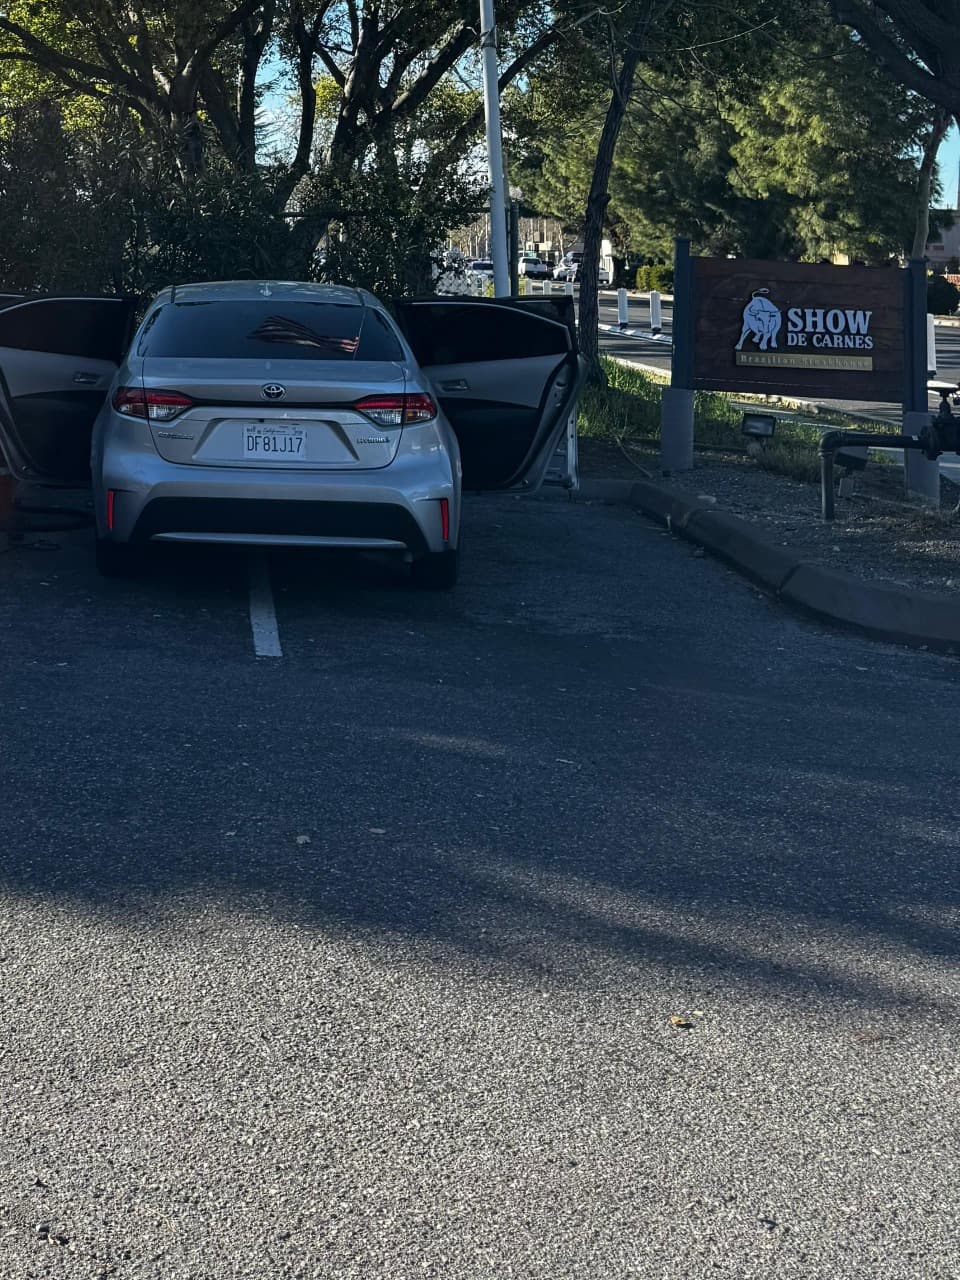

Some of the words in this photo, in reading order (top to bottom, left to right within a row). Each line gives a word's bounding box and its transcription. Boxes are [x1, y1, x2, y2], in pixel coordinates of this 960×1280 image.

[787, 307, 873, 334] SHOW
[787, 333, 808, 346] DE
[812, 334, 873, 349] CARNES
[740, 354, 795, 366] Brazilian
[247, 435, 303, 453] DF81J17
